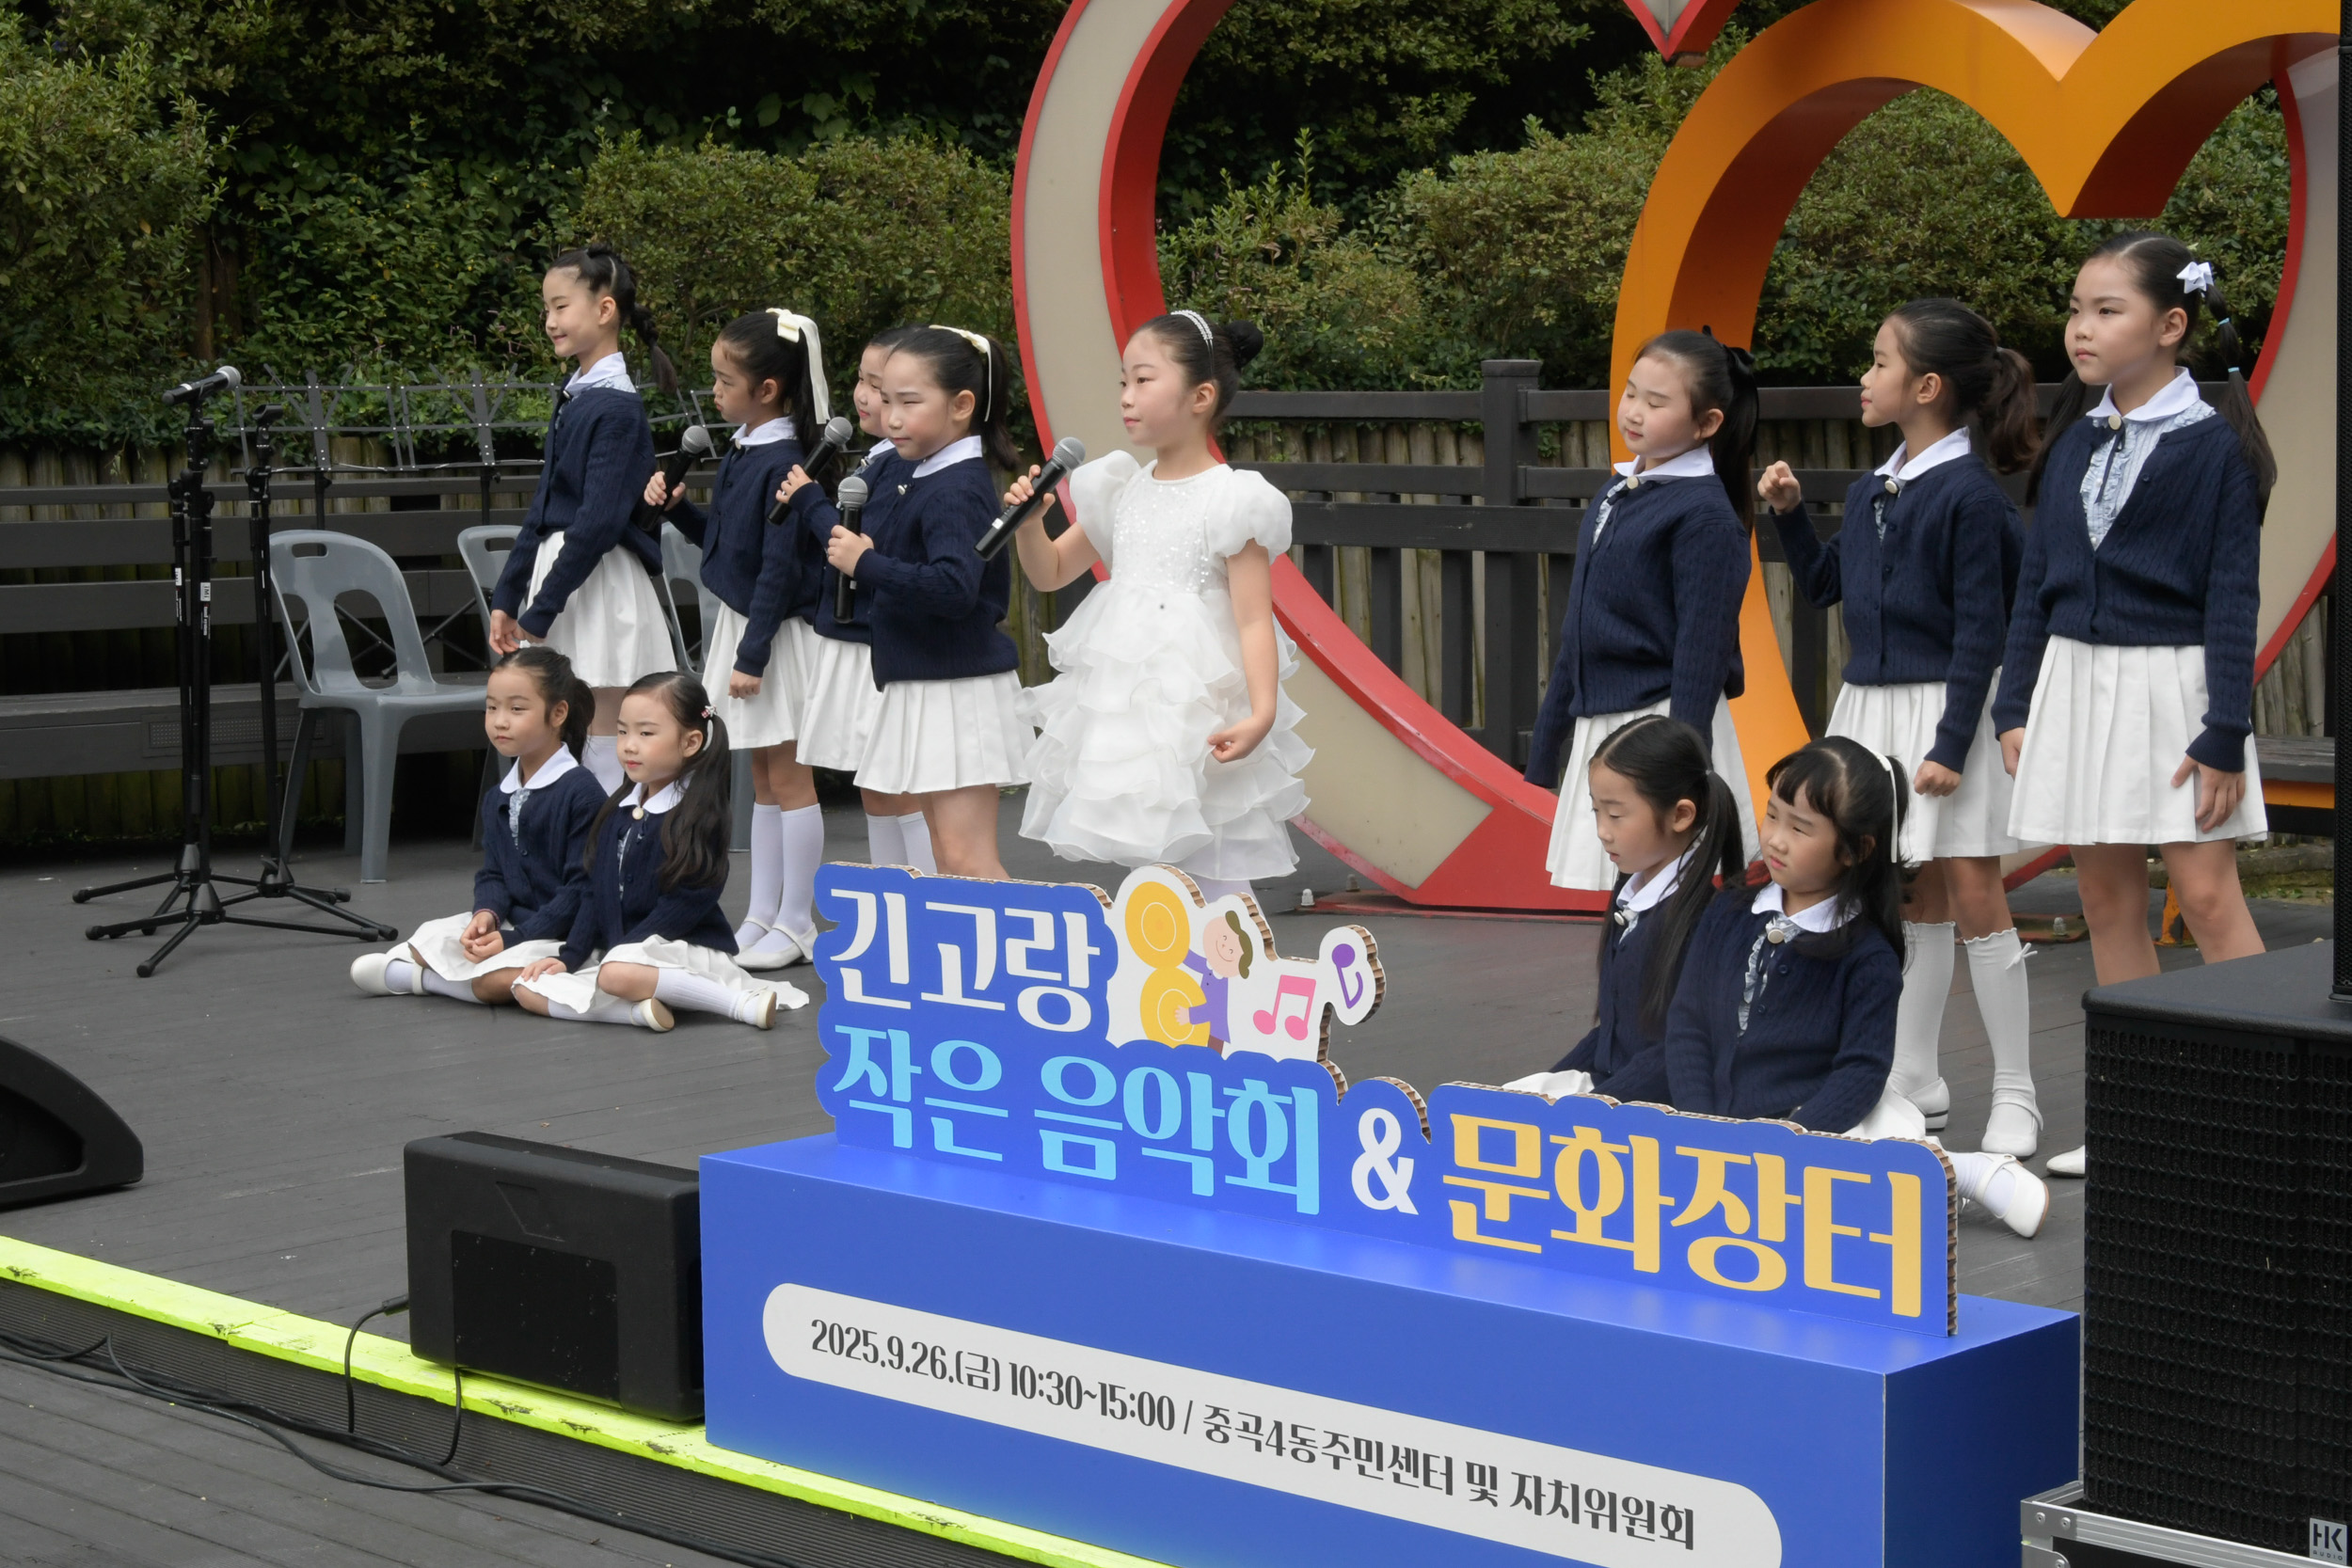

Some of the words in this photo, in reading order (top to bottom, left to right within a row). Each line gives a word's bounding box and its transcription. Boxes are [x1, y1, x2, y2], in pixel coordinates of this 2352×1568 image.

[830, 889, 1101, 1033] 긴고랑
[833, 1024, 1009, 1163] 작은
[1034, 1055, 1320, 1215] 음악회
[1351, 1108, 1419, 1215] &
[1442, 1113, 1922, 1318] 문화장터
[812, 1319, 1000, 1392] 2025.9.26.(금)
[1009, 1362, 1176, 1432] 10:30~15:00
[1183, 1400, 1194, 1434] /
[1202, 1404, 1454, 1497] 중곡4동주민센터
[1465, 1461, 1499, 1508] 및
[1510, 1471, 1694, 1551] 자치위원회
[2313, 1523, 2344, 1552] HK
